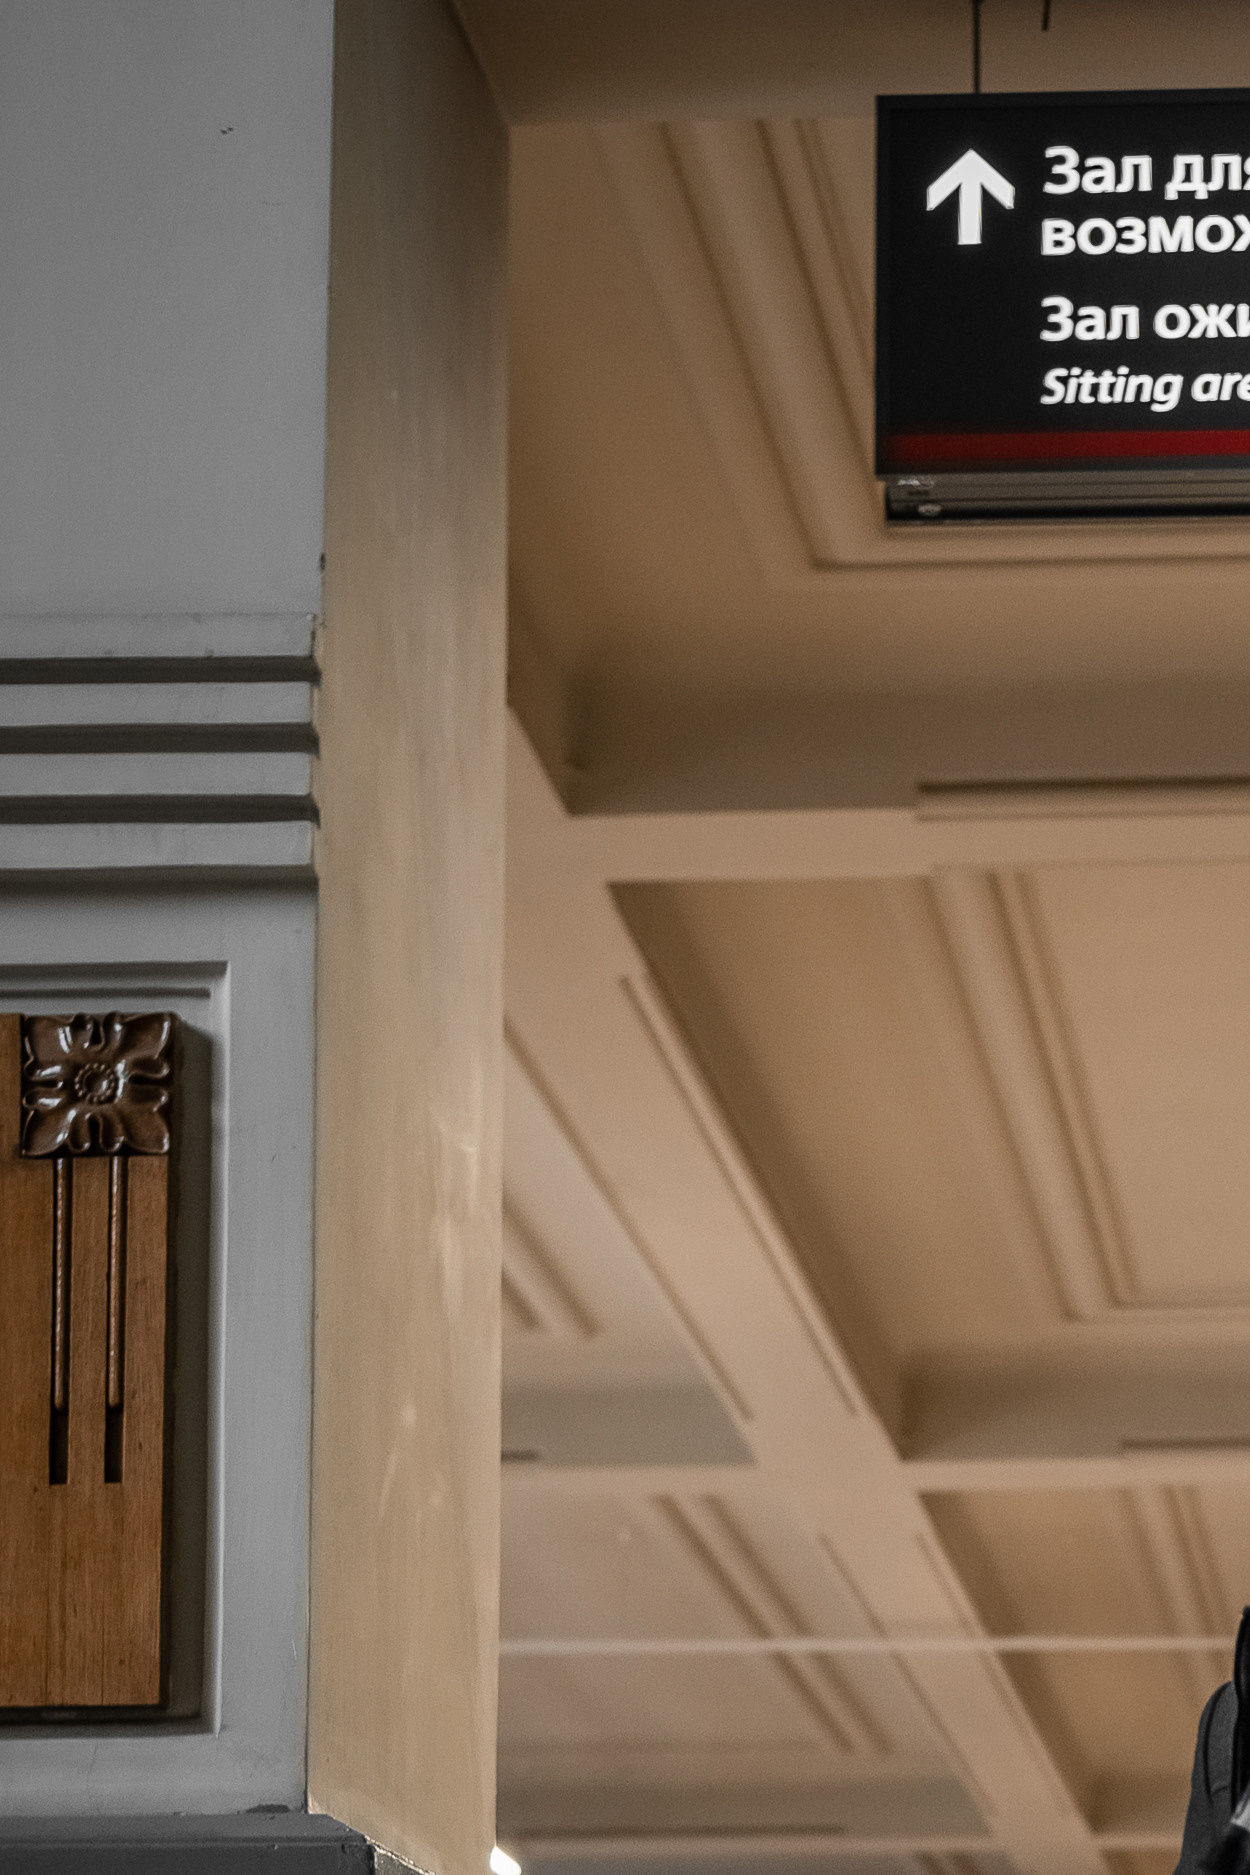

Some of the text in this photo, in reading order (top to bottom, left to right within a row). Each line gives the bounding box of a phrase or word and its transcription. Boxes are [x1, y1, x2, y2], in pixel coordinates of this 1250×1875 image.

[1042, 146, 1153, 195] Зал
[1039, 296, 1140, 342] Зал
[1039, 365, 1184, 413] Sitting
